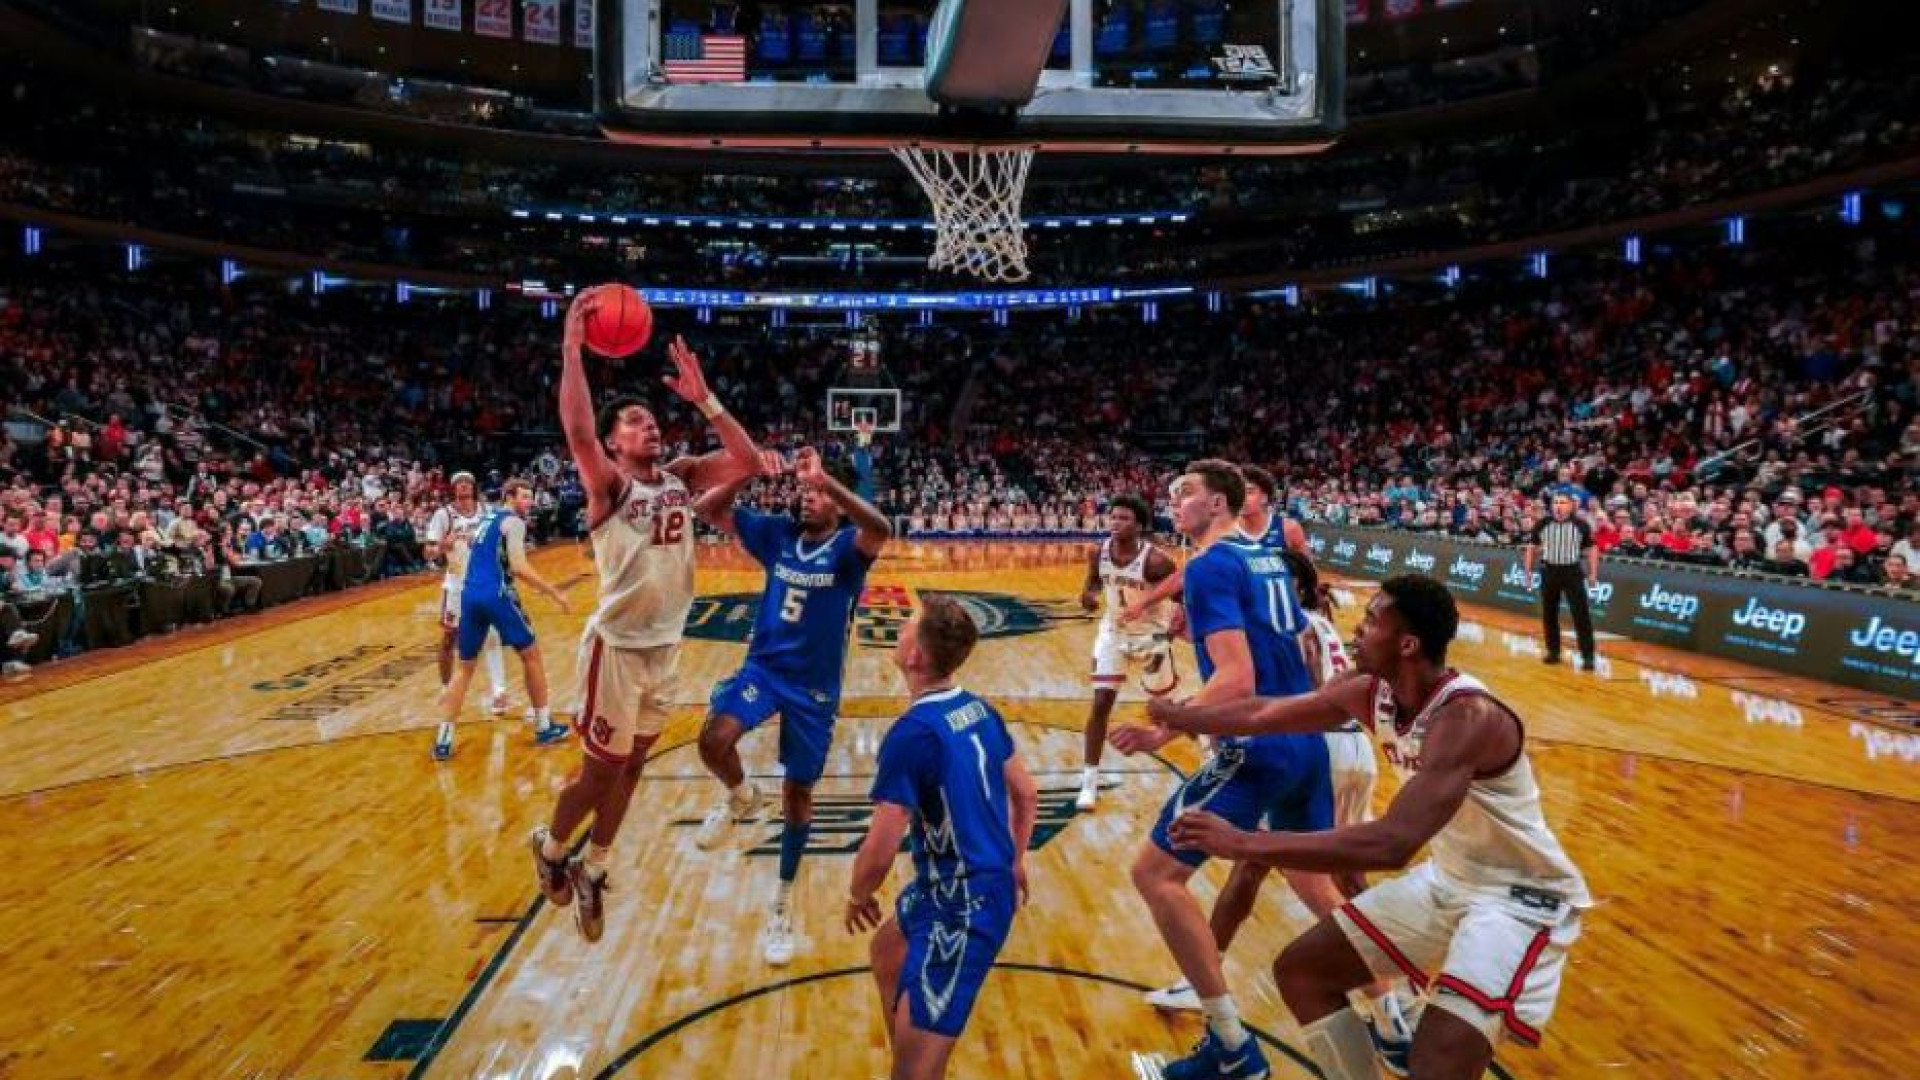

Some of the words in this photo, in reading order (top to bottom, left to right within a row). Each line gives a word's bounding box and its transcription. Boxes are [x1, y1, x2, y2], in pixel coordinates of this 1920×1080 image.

[651, 510, 684, 546] 12
[1405, 547, 1435, 573] Jeep
[1450, 554, 1485, 583] Jeep
[1502, 562, 1541, 592] Jep
[780, 587, 808, 622] 5
[1266, 577, 1295, 634] 11
[1639, 583, 1699, 621] Jeep
[1732, 596, 1806, 639] Jeep
[968, 732, 991, 800] 1
